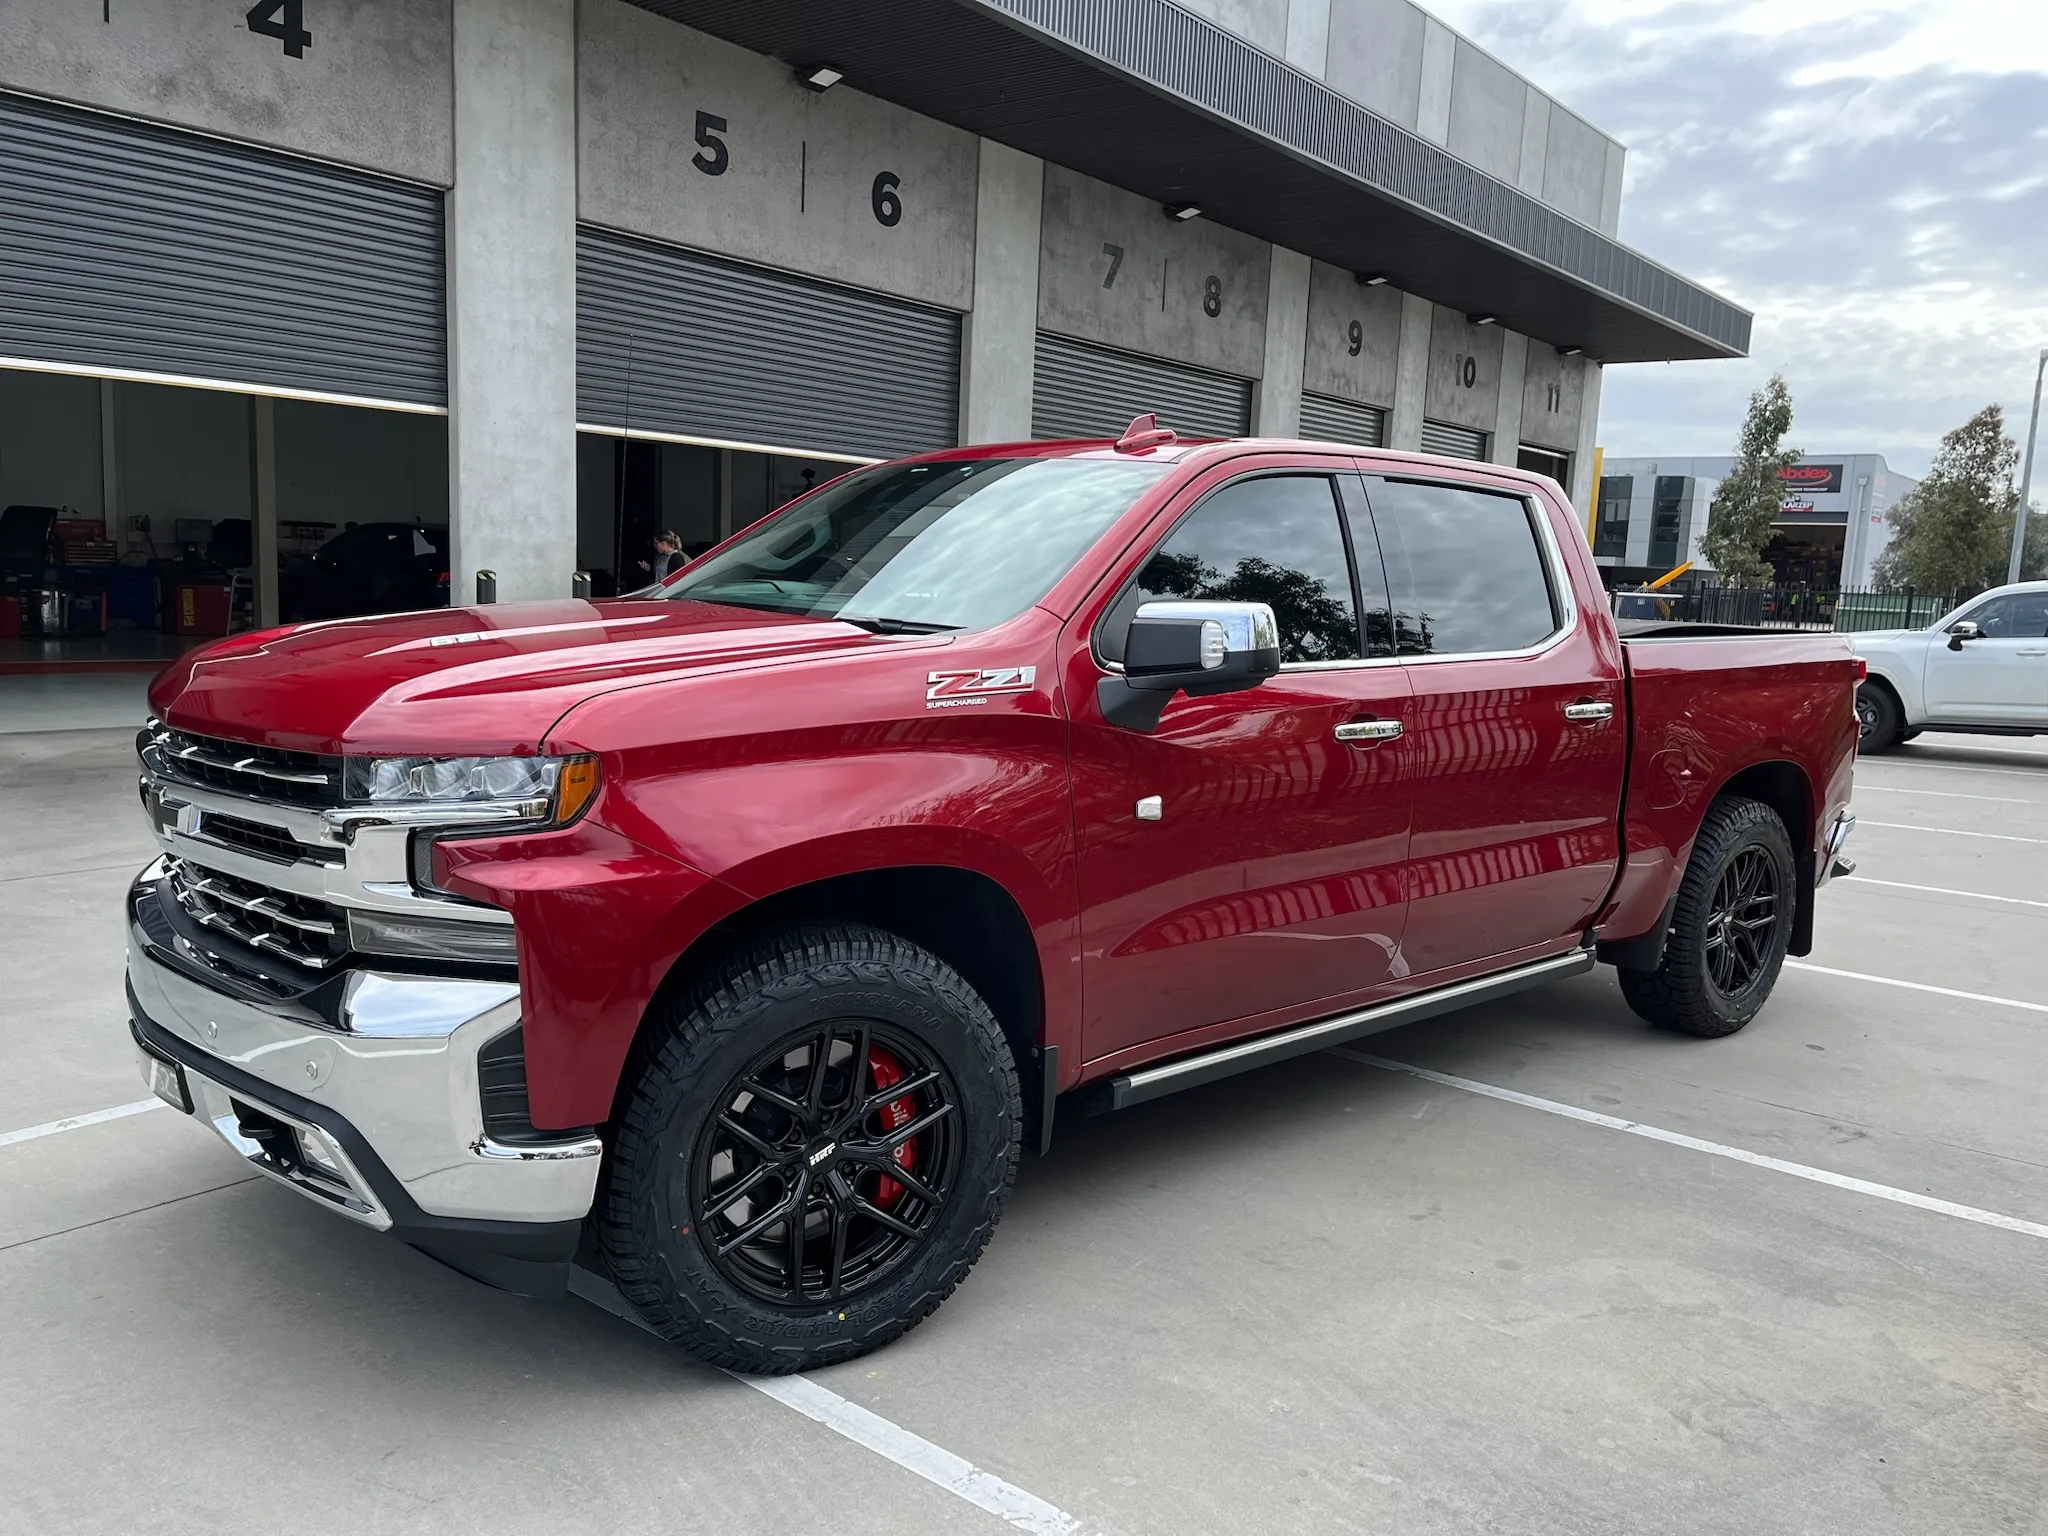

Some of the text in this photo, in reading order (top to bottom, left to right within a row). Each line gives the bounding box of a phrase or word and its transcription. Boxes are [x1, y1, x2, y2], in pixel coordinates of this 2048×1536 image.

[246, 0, 311, 59] 4
[692, 110, 728, 176] 5
[872, 171, 901, 227] 6
[1102, 242, 1124, 289] 7
[1203, 275, 1221, 317] 8
[1348, 320, 1362, 356] 9
[1455, 353, 1476, 388] 10
[1547, 382, 1560, 413] 11
[1783, 501, 1813, 509] LARZEP
[926, 666, 1037, 700] Z71
[925, 698, 988, 710] SUPERCHARGED
[810, 991, 945, 1031] YOKOHAMA
[744, 1282, 914, 1339] GEOLANDAR
